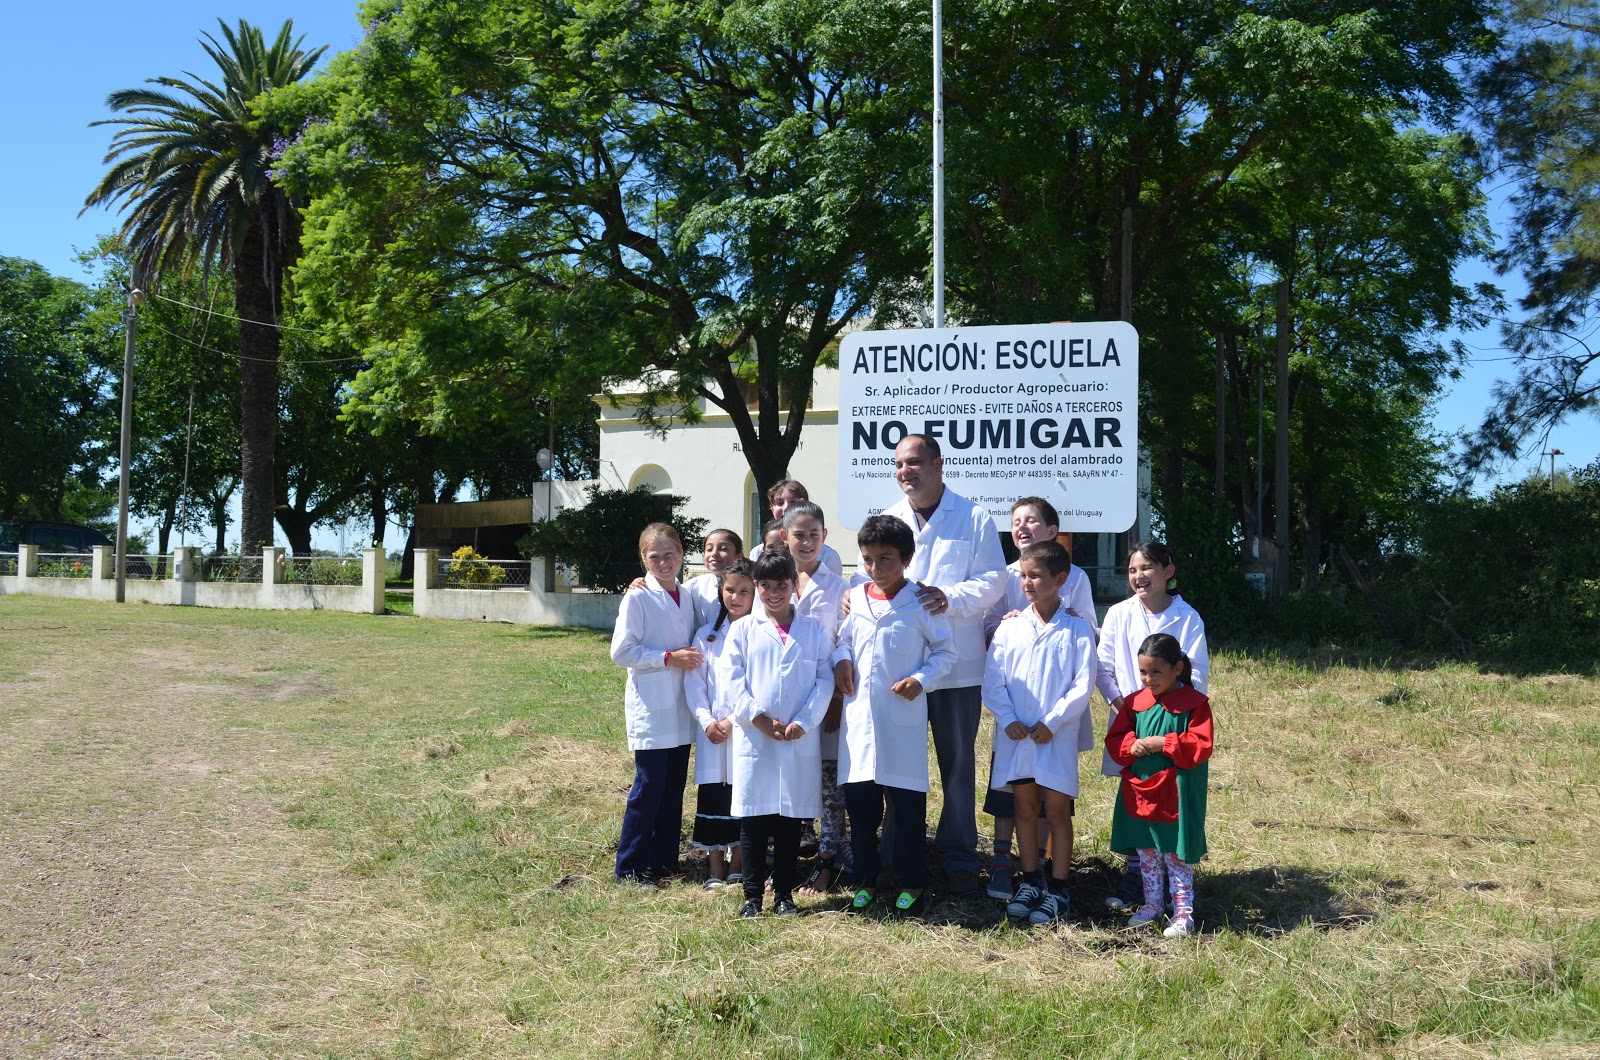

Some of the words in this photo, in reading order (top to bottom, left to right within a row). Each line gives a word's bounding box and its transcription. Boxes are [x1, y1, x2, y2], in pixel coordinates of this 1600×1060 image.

[853, 334, 985, 374] ATENCIÓN:
[996, 338, 1121, 369] ESCUELA
[865, 386, 879, 396] Sr.
[883, 384, 941, 398] Aplicador
[952, 384, 1014, 394] Productor
[1017, 381, 1108, 396] Agropecuario:
[852, 406, 896, 416] EXTREME
[899, 404, 976, 415] PRECAUCIONES
[985, 403, 1013, 414] EVITE
[1017, 400, 1052, 413] DAÑOS
[1055, 403, 1063, 413] A
[1065, 401, 1122, 413] TERCEROS
[853, 420, 908, 450] NO
[924, 417, 1123, 450] FUMIGAR
[861, 457, 896, 467] menos
[943, 454, 994, 468] incuenta)
[997, 455, 1036, 465] metros
[1040, 454, 1056, 464] del
[1061, 454, 1122, 464] alambrado
[855, 471, 865, 479] Ley
[1073, 470, 1100, 479] SAAyRN
[970, 495, 979, 503] de
[988, 508, 1012, 516] Ambien
[1076, 509, 1102, 517] Uruguay
